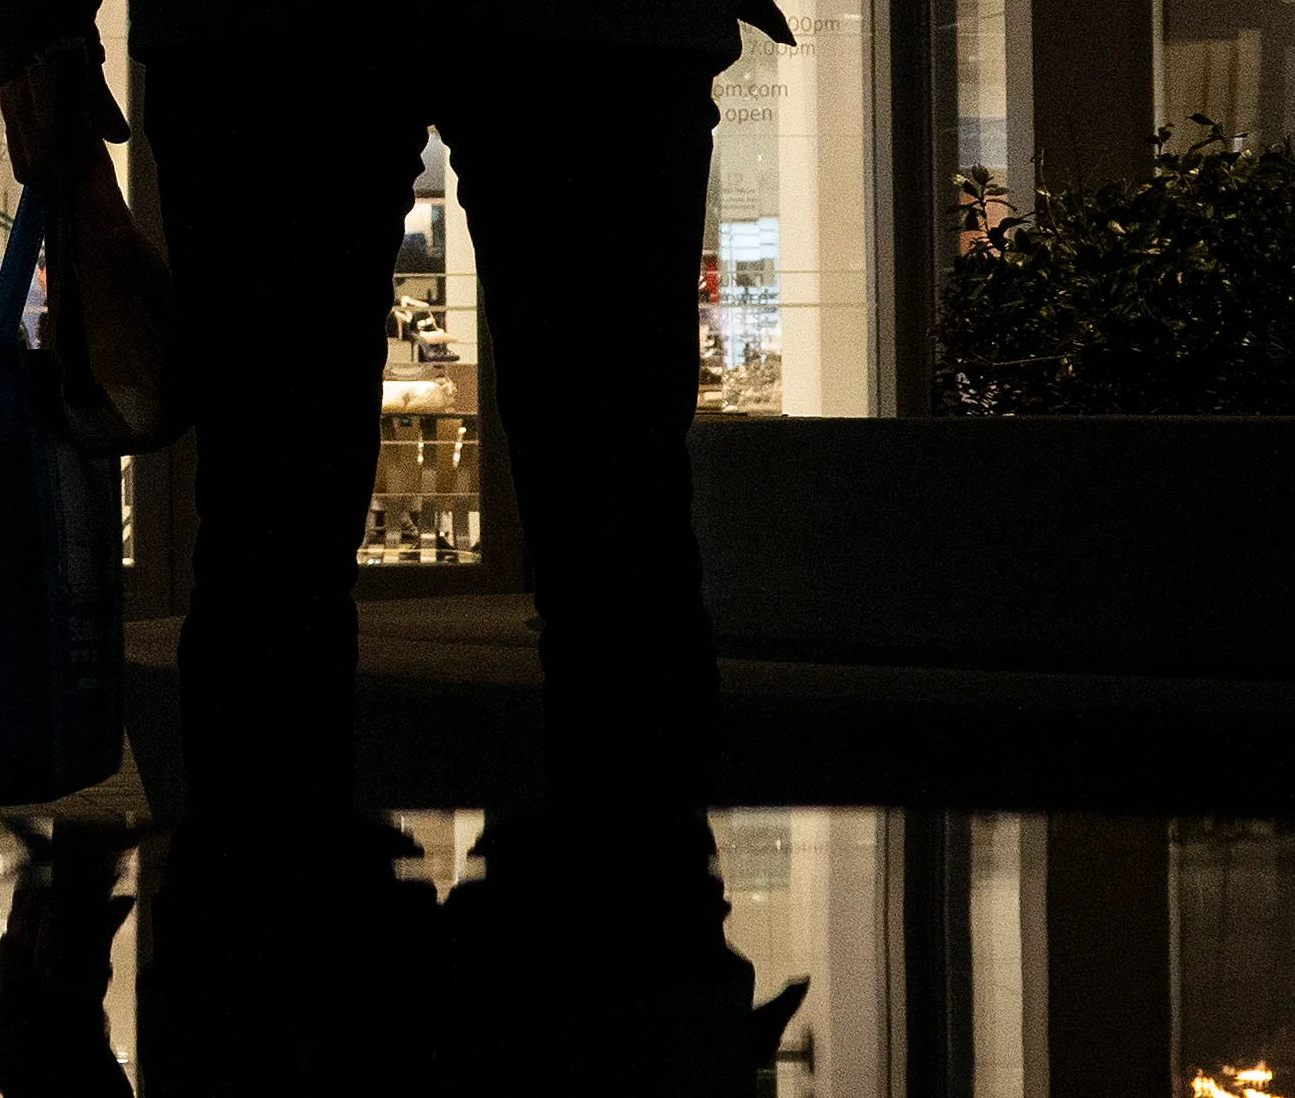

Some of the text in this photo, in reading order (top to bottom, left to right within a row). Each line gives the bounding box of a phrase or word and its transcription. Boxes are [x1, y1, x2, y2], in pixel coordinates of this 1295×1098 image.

[788, 16, 841, 32] 00pm
[713, 83, 788, 98] om.com
[725, 108, 773, 124] open
